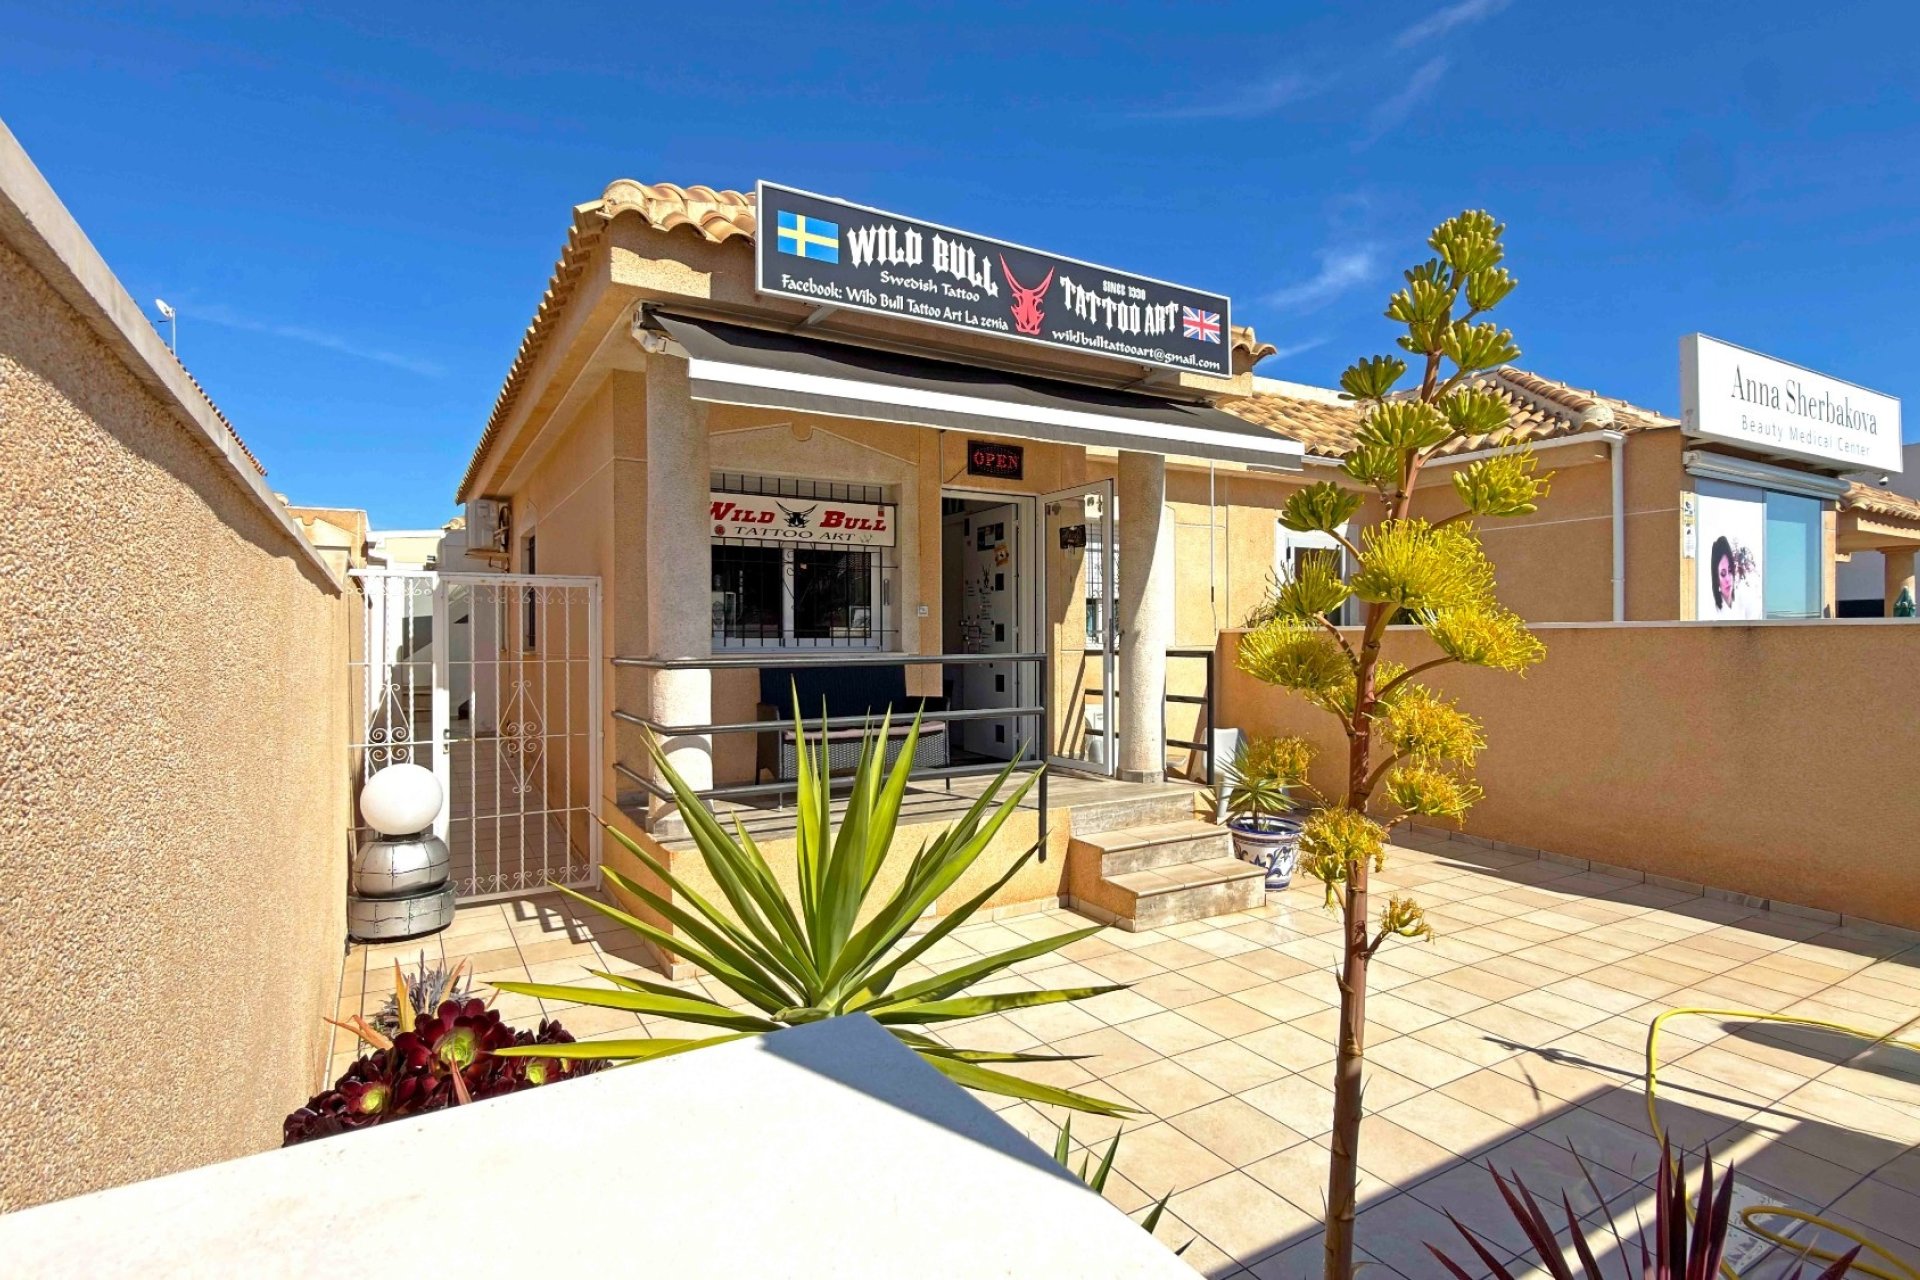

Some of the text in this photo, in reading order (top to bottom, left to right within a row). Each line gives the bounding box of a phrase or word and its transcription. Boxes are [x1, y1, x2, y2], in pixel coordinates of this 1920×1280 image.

[846, 224, 999, 298] WILD BULL
[781, 273, 1009, 331] Facebook: Wild Bull Tattoo Art La zenia
[880, 270, 980, 303] Swedish Tattoo
[1059, 275, 1179, 337] TATTOO ART
[1102, 279, 1126, 297] SINCE
[1052, 329, 1221, 371] wildbulltattooart@gmail.com
[1731, 364, 1878, 436] Anna Sherbakova
[1741, 414, 1871, 456] Beauty Medical Center
[973, 450, 1018, 470] OPEN
[735, 526, 856, 542] TATTOO ART
